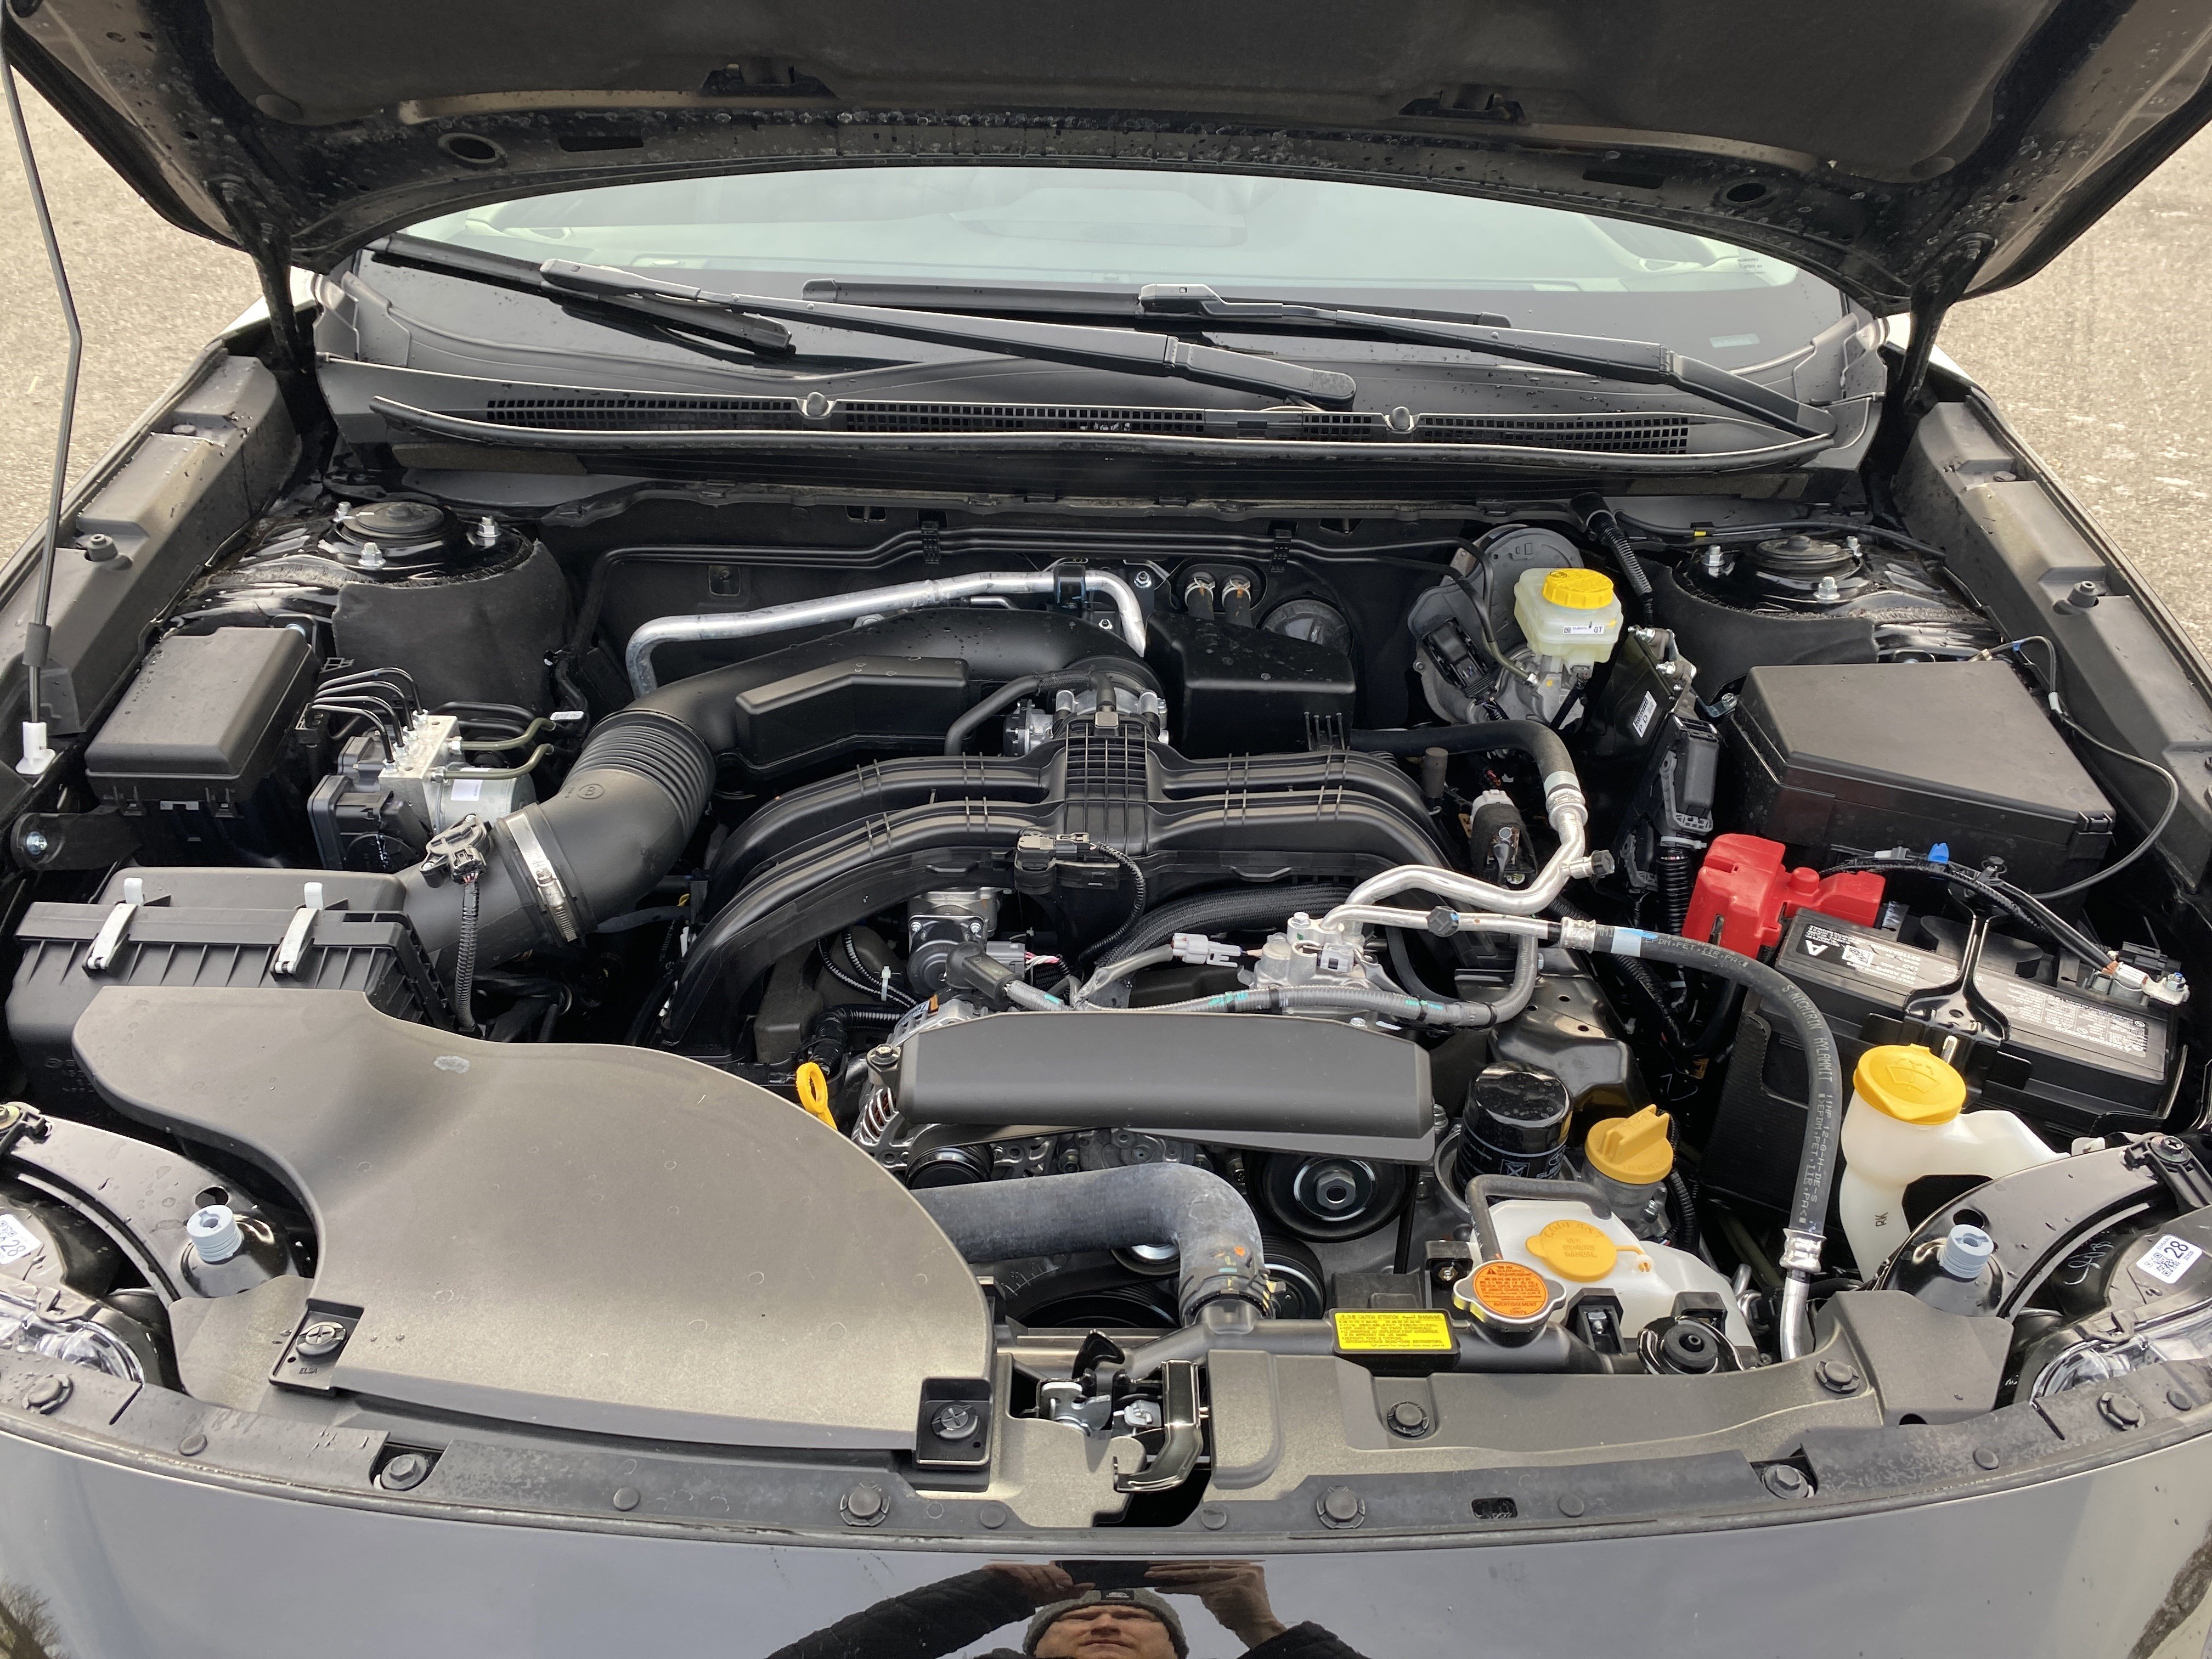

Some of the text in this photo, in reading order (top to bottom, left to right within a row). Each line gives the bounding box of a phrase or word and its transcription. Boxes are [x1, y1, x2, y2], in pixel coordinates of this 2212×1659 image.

[1788, 992, 1823, 1030] NICHIRIN
[1814, 1037, 1833, 1085] HYLAMMIT
[2055, 1025, 2123, 1051] DANGER/POISON
[1, 1239, 26, 1257] 28
[2164, 1240, 2189, 1259] 28
